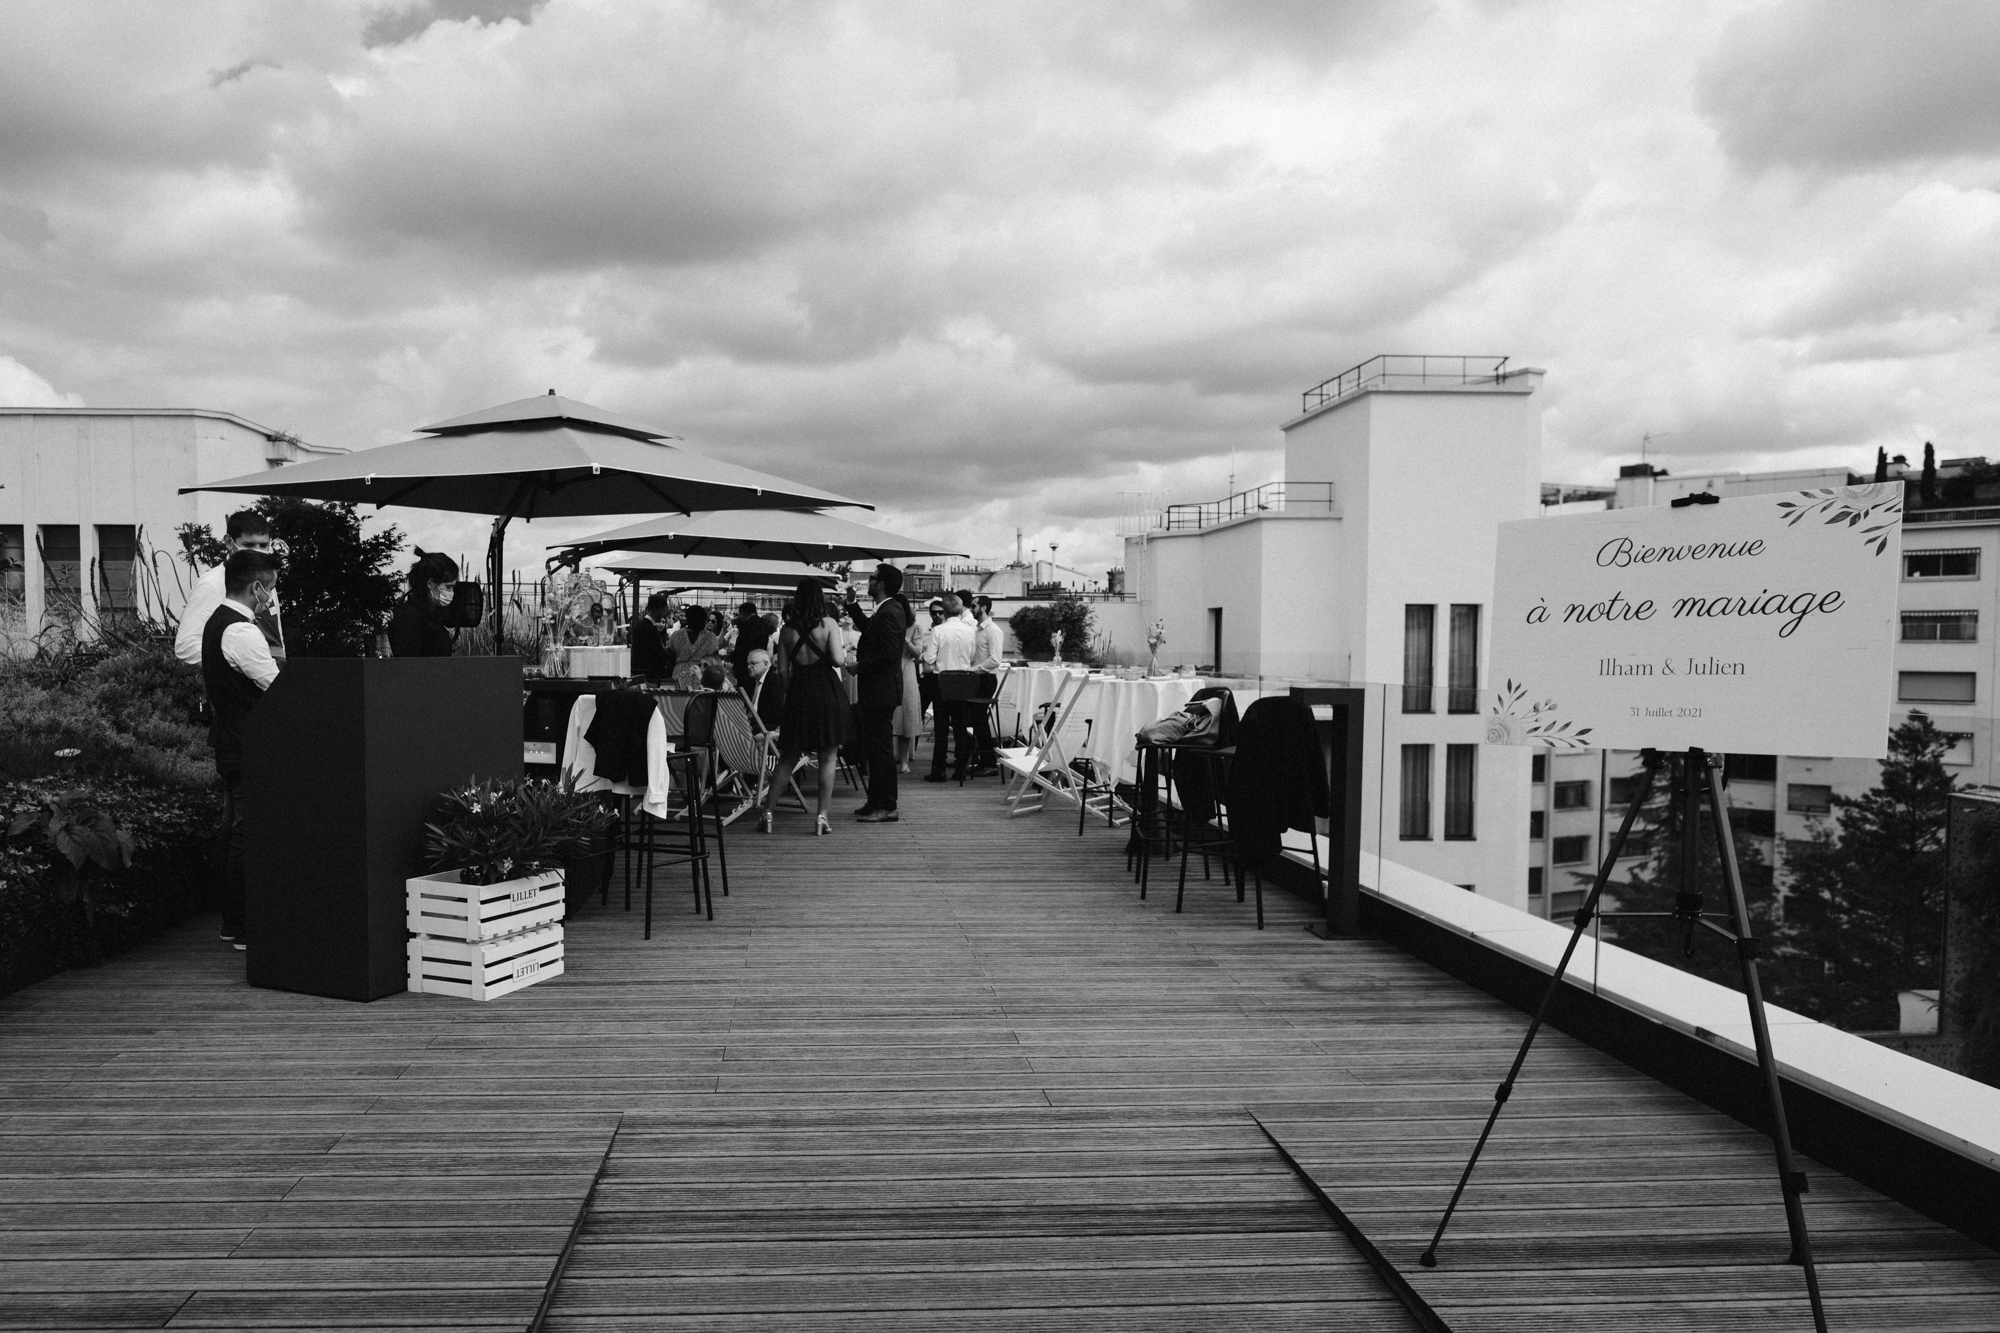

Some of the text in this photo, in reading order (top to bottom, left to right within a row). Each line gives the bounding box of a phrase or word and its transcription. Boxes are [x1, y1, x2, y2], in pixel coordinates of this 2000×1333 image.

[1595, 536, 1767, 568] Bienvenue
[1525, 588, 1846, 639] à notre mariage
[1599, 656, 1745, 677] Ilham & Julien
[1629, 706, 1702, 718] 31 Juillet 2021
[512, 888, 537, 902] LILLET
[515, 962, 539, 978] LILLET
